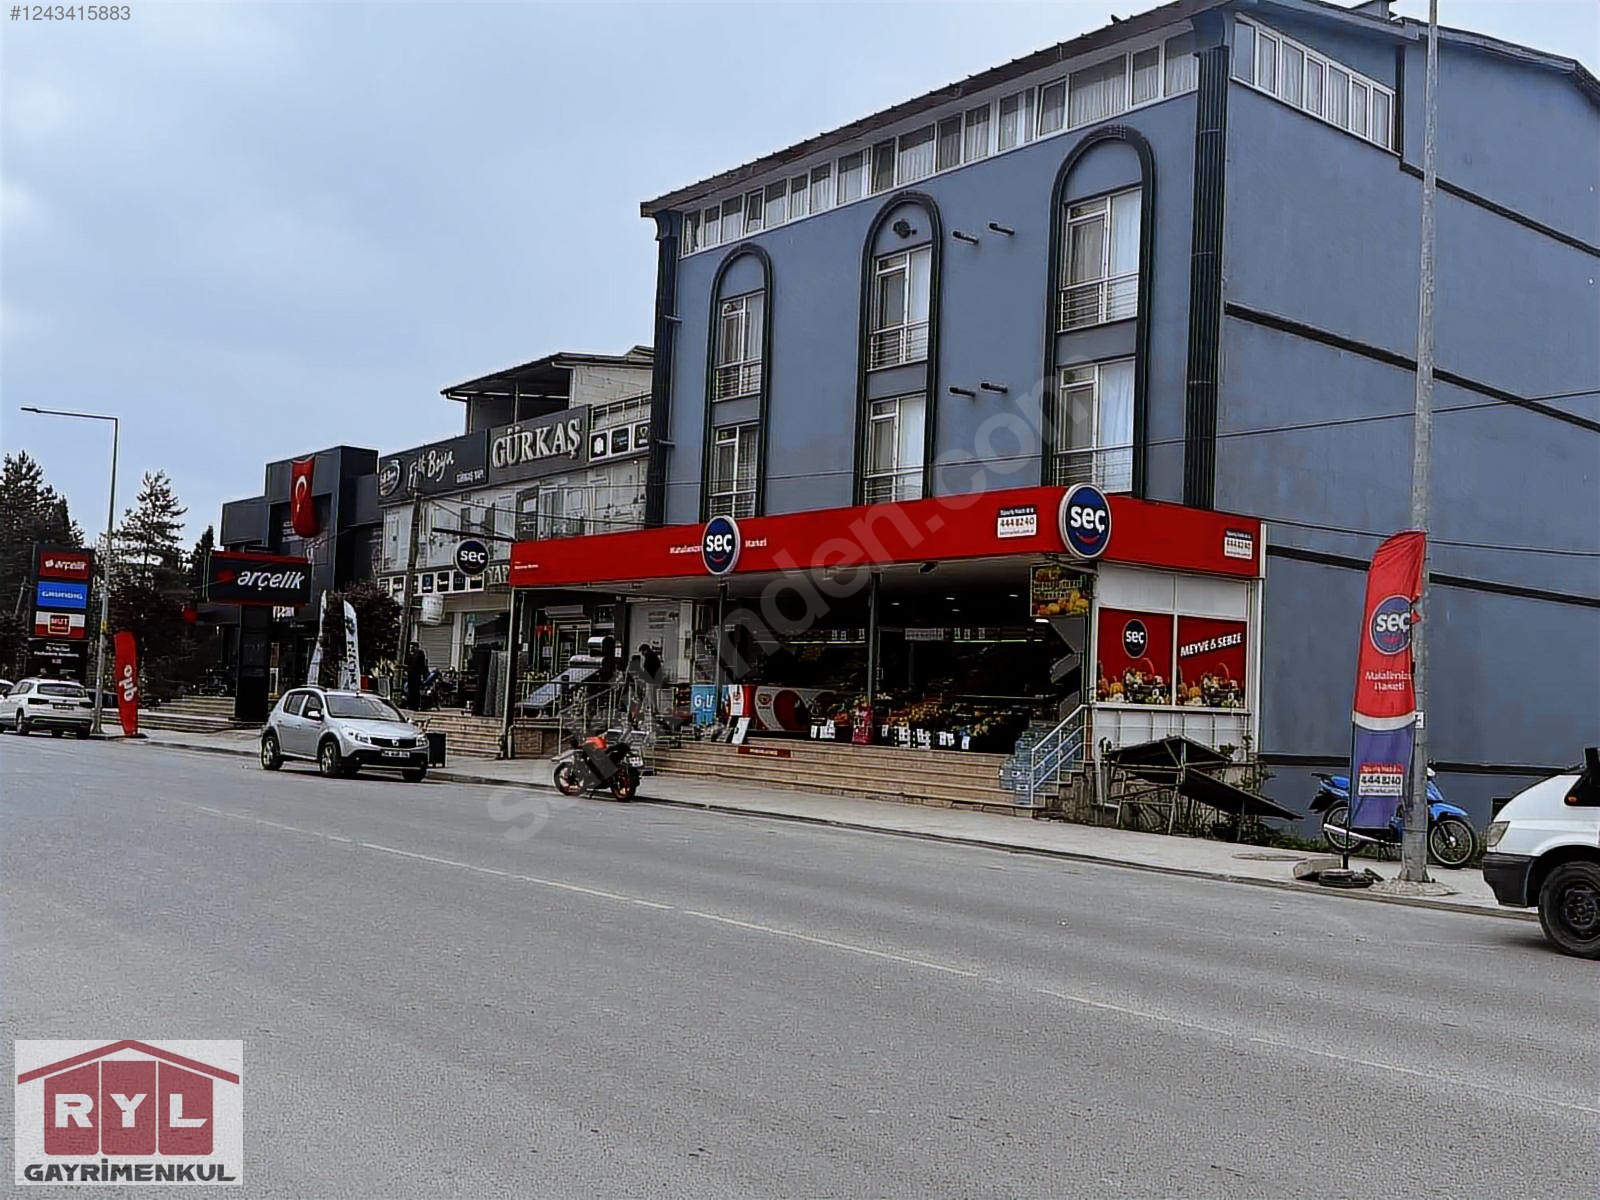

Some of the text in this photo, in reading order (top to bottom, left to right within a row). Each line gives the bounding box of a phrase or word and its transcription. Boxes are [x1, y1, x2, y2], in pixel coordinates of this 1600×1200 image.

[492, 417, 581, 468] GÜRKAŞ
[1070, 505, 1106, 533] seç
[706, 533, 732, 553] seç
[460, 550, 486, 564] seç
[237, 570, 305, 591] arçelik
[1125, 630, 1145, 645] seç
[1180, 639, 1210, 657] MEYVE
[1217, 632, 1242, 648] SEBZE
